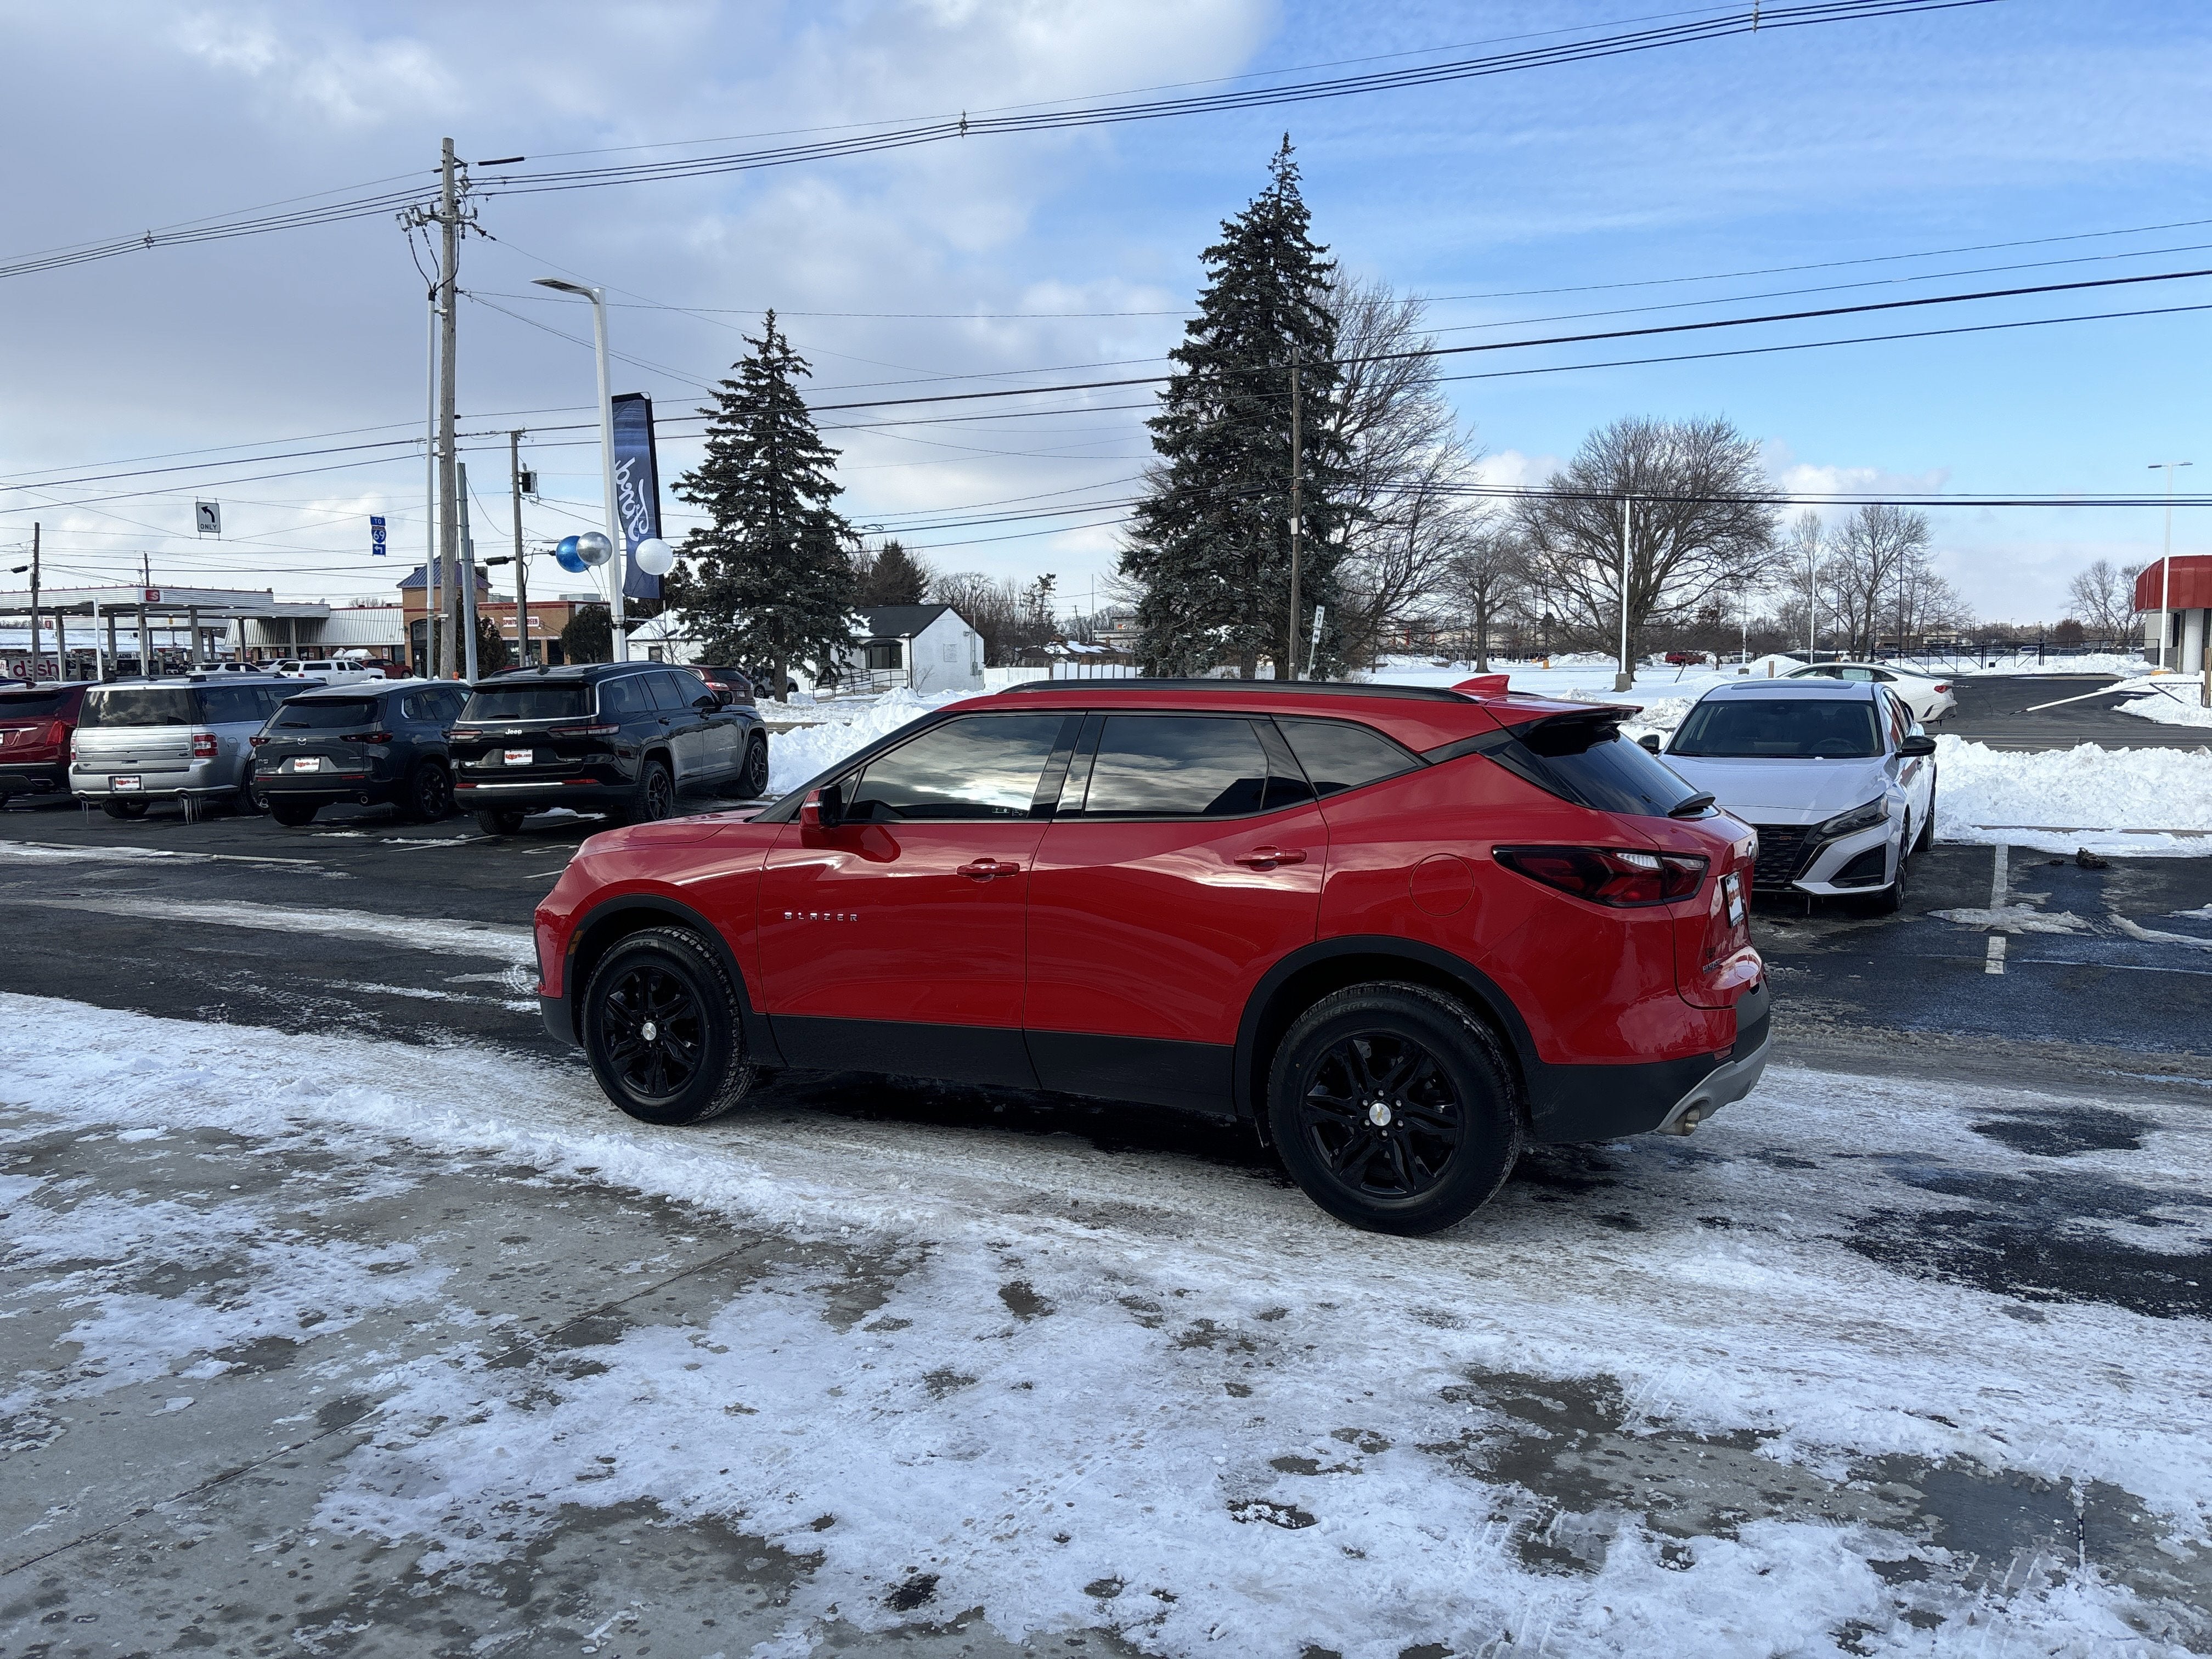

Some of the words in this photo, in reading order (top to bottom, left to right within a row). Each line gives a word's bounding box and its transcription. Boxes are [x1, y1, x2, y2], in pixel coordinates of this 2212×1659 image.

[615, 457, 649, 542] Ford
[373, 530, 385, 540] 69
[1317, 613, 1322, 626] 9
[784, 912, 857, 922] BLAZER
